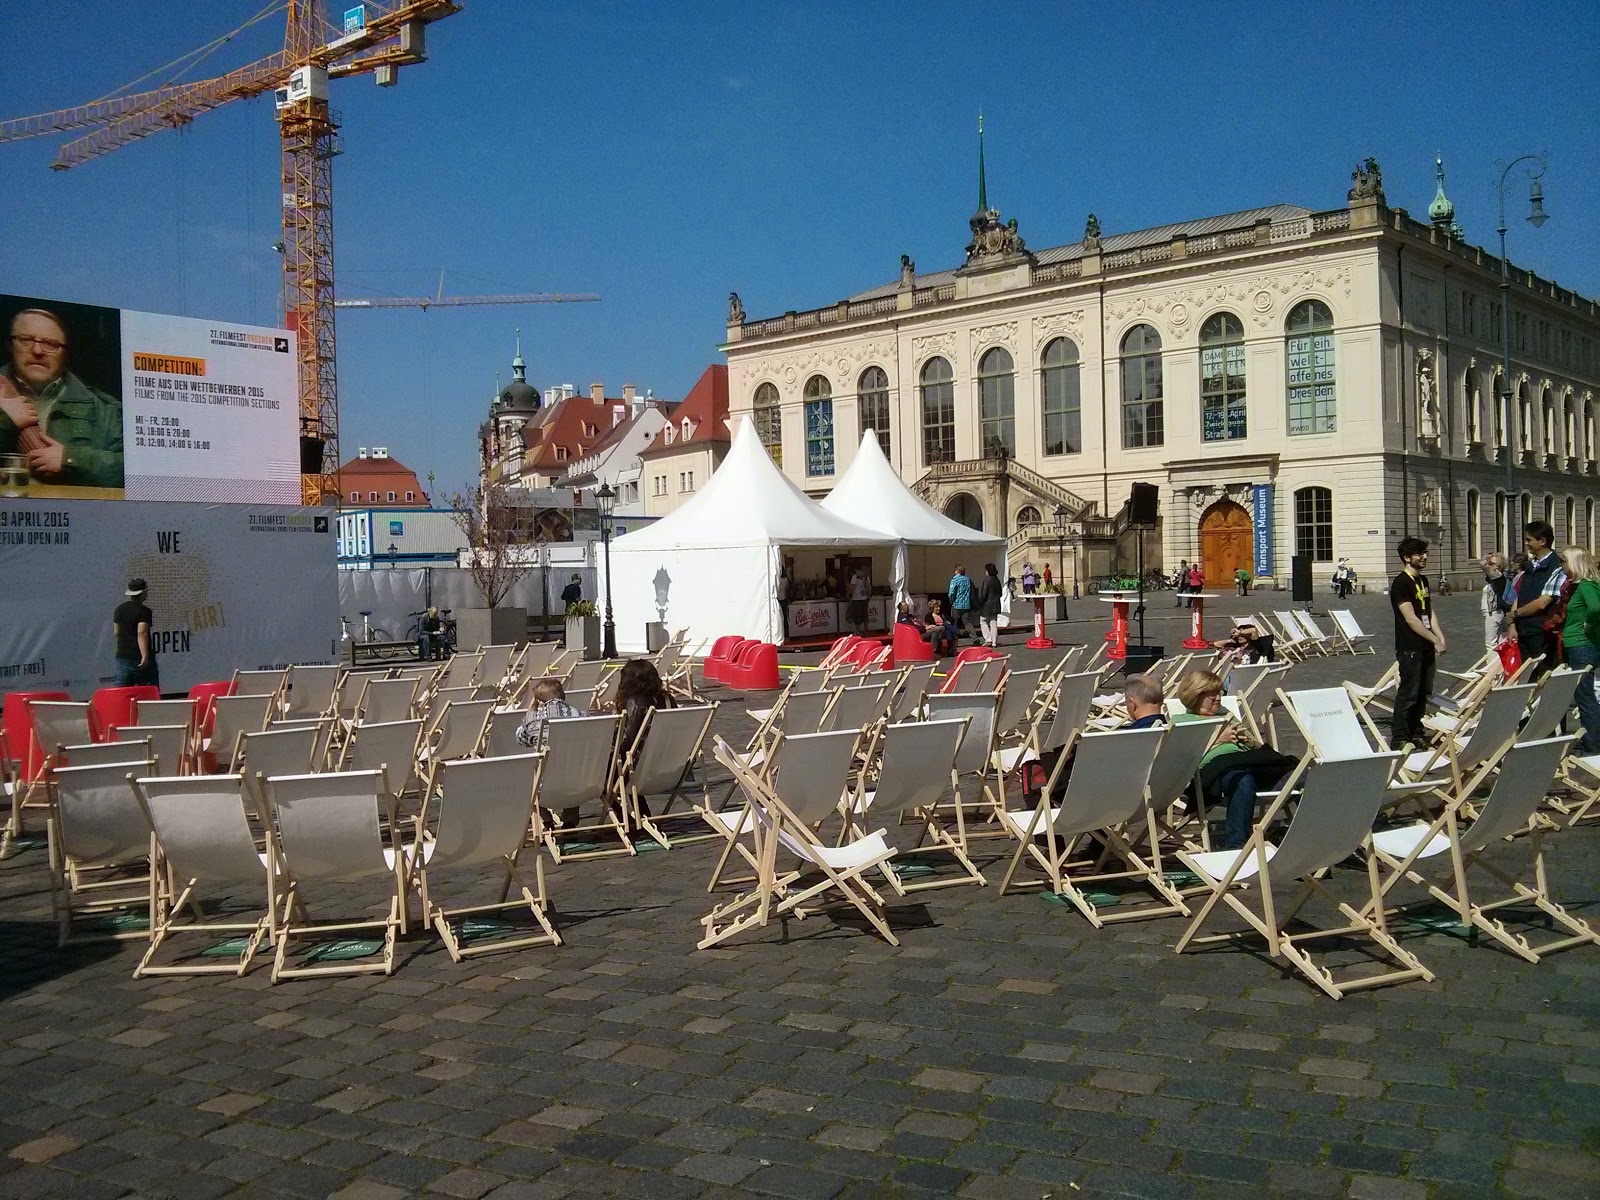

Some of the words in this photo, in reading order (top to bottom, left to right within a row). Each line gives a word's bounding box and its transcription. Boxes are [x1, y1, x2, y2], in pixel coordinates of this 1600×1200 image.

[210, 330, 219, 338] 27.
[220, 331, 246, 342] FILMFEST
[1290, 340, 1308, 352] Für
[1314, 338, 1330, 348] ein
[134, 356, 202, 376] COMPETITON:
[1290, 354, 1324, 367] welt-
[1290, 370, 1333, 382] offenes
[134, 376, 155, 388] FILME
[158, 378, 172, 390] AUS
[174, 380, 188, 391] DEN
[190, 381, 246, 396] WETTBEWERBEN
[248, 386, 264, 398] 2015
[1290, 386, 1333, 399] Dresden
[134, 388, 155, 400] FILMS
[157, 391, 175, 401] FROM
[177, 392, 189, 403] THE
[191, 393, 207, 404] 2015
[208, 395, 249, 408] COMPETITION
[251, 399, 280, 410] SECTIONS
[1230, 409, 1245, 419] April
[135, 416, 143, 425] MI
[161, 417, 179, 427] 20:00
[135, 426, 145, 436] SA,
[147, 427, 165, 436] 18:00
[166, 428, 171, 436] &
[172, 429, 190, 438] 20:00
[135, 437, 146, 447] SO,
[148, 438, 167, 448] 12:00,
[169, 440, 186, 448] 14:00
[193, 441, 210, 450] 16:00
[1258, 489, 1266, 527] Museum
[11, 511, 41, 527] APRIL
[44, 512, 69, 527] 2015
[259, 515, 285, 525] FILMFEST
[28, 532, 50, 544] OPEN
[55, 532, 69, 544] AIR
[157, 531, 180, 553] WE
[1258, 530, 1268, 573] Transport
[152, 630, 190, 654] OPEN
